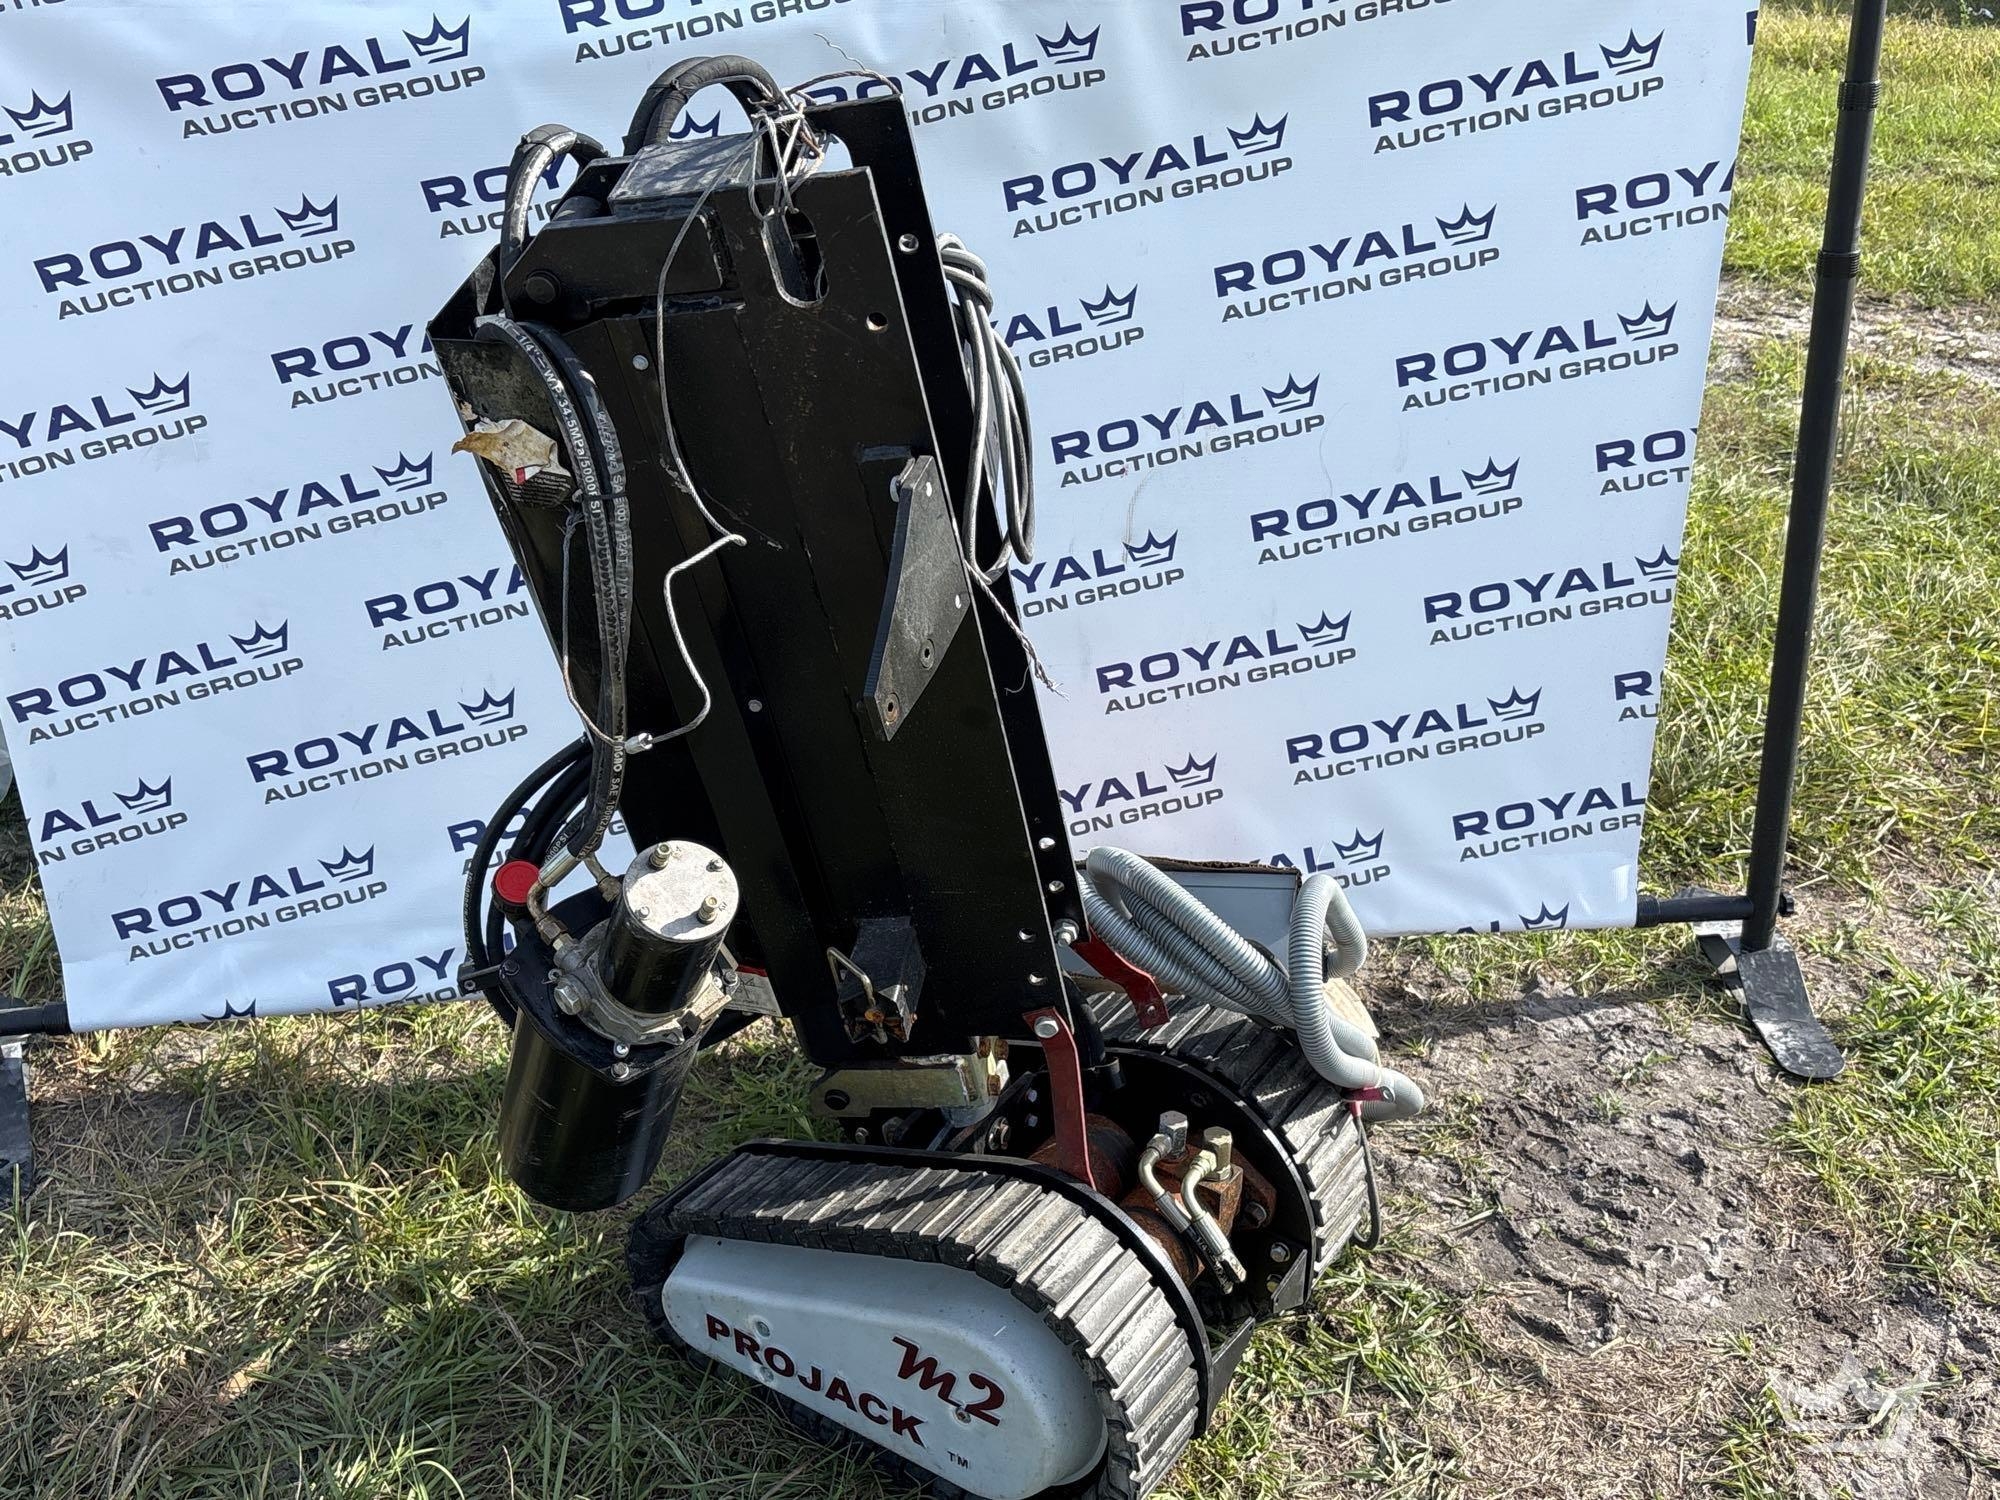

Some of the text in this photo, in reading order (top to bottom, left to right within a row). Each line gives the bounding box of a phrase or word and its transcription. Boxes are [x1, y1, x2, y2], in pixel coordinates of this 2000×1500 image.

[576, 8, 743, 63] AUCTION
[1187, 9, 1345, 62] AUCTION
[155, 37, 411, 111] ROYAL
[184, 66, 485, 139] AUCTION GROUP
[982, 69, 1105, 110] GROUP
[1368, 51, 1599, 128] ROYAL
[1374, 77, 1663, 154] AUCTION GROUP
[1003, 135, 1228, 212] ROYAL
[1013, 157, 1292, 238] AUCTION GROUP
[1575, 160, 1735, 220] ROY
[33, 214, 284, 293] ROYAL
[59, 240, 355, 320] AUCTION GROUP
[1214, 224, 1436, 298] ROYAL
[1222, 248, 1499, 323] AUCTION GROUP
[271, 324, 433, 384] ROY
[1029, 327, 1144, 367] GROUP
[1396, 319, 1617, 387] ROYAL
[1402, 343, 1678, 412] AUCTION GROUP
[0, 395, 136, 449] YAL
[81, 415, 207, 459] GROUP
[1051, 394, 1264, 465] ROYAL
[1061, 415, 1324, 488] AUCTION GROUP
[148, 474, 367, 553] ROYAL
[1250, 476, 1462, 542] ROYAL
[1601, 467, 1690, 496] AUCT
[170, 492, 447, 576] AUCTION GROUP
[1258, 497, 1522, 565] AUCTION GROUP
[1010, 548, 1125, 593] YAL
[1075, 568, 1184, 605] GROUP
[1424, 562, 1634, 623] ROYAL
[383, 601, 529, 651] AUCTION
[1430, 589, 1672, 645] AUCTION GROU
[7, 642, 237, 724] ROYAL
[1096, 629, 1298, 694] ROYAL
[1105, 648, 1356, 714] AUCTION GROUP
[30, 658, 303, 745] AUCTION GROUP
[1286, 703, 1488, 764] ROYAL
[246, 709, 465, 783] ROYAL
[265, 725, 528, 804] AUCTION GROUP
[1294, 723, 1545, 785] AUCTION GROUP
[1060, 771, 1167, 813] YAL
[1120, 789, 1223, 824] GROUP
[1453, 782, 1646, 841] ROYAL
[71, 813, 188, 855] GROUP
[1460, 822, 1593, 862] AUCTION
[111, 867, 325, 942] ROYAL
[129, 882, 387, 962] AUCTION GROUP
[705, 1313, 926, 1449] PROJACK
